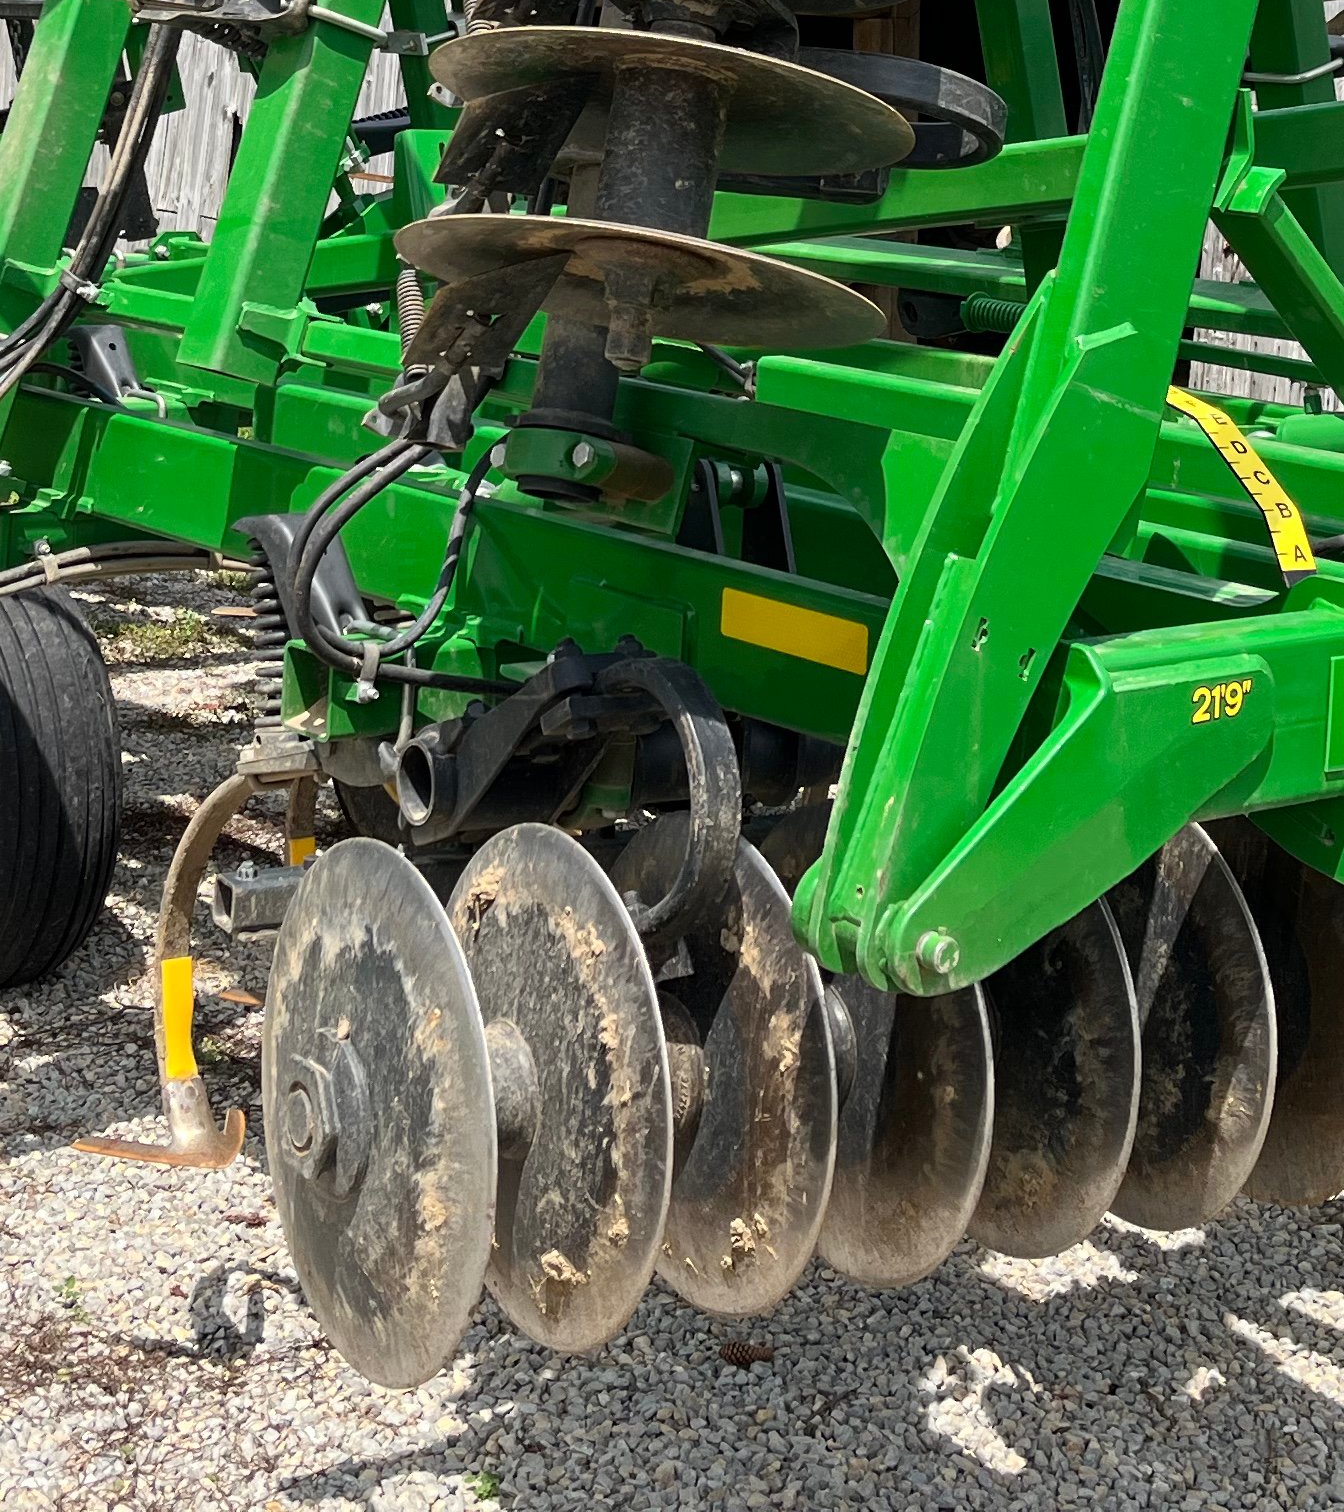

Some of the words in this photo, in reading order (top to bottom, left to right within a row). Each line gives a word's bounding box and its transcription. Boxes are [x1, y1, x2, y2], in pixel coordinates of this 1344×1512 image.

[1231, 441, 1247, 454] D
[1253, 471, 1270, 484] C
[1275, 503, 1292, 518] B
[1294, 545, 1308, 562] A
